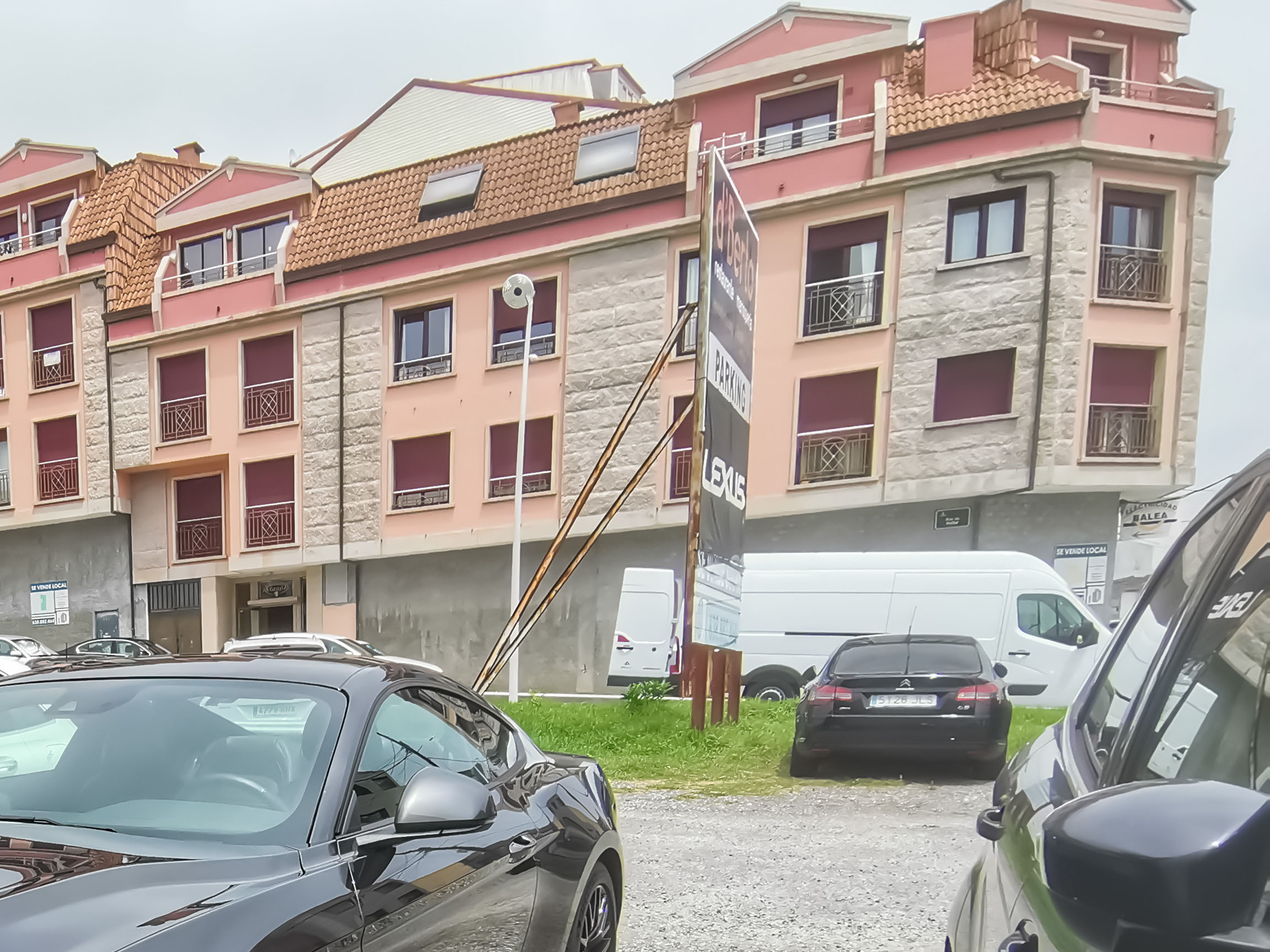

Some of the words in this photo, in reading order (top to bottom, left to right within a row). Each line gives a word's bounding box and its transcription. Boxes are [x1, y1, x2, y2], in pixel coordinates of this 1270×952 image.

[714, 348, 746, 413] PARKING
[702, 448, 746, 511] LEXUS
[1086, 546, 1107, 554] LOCAL
